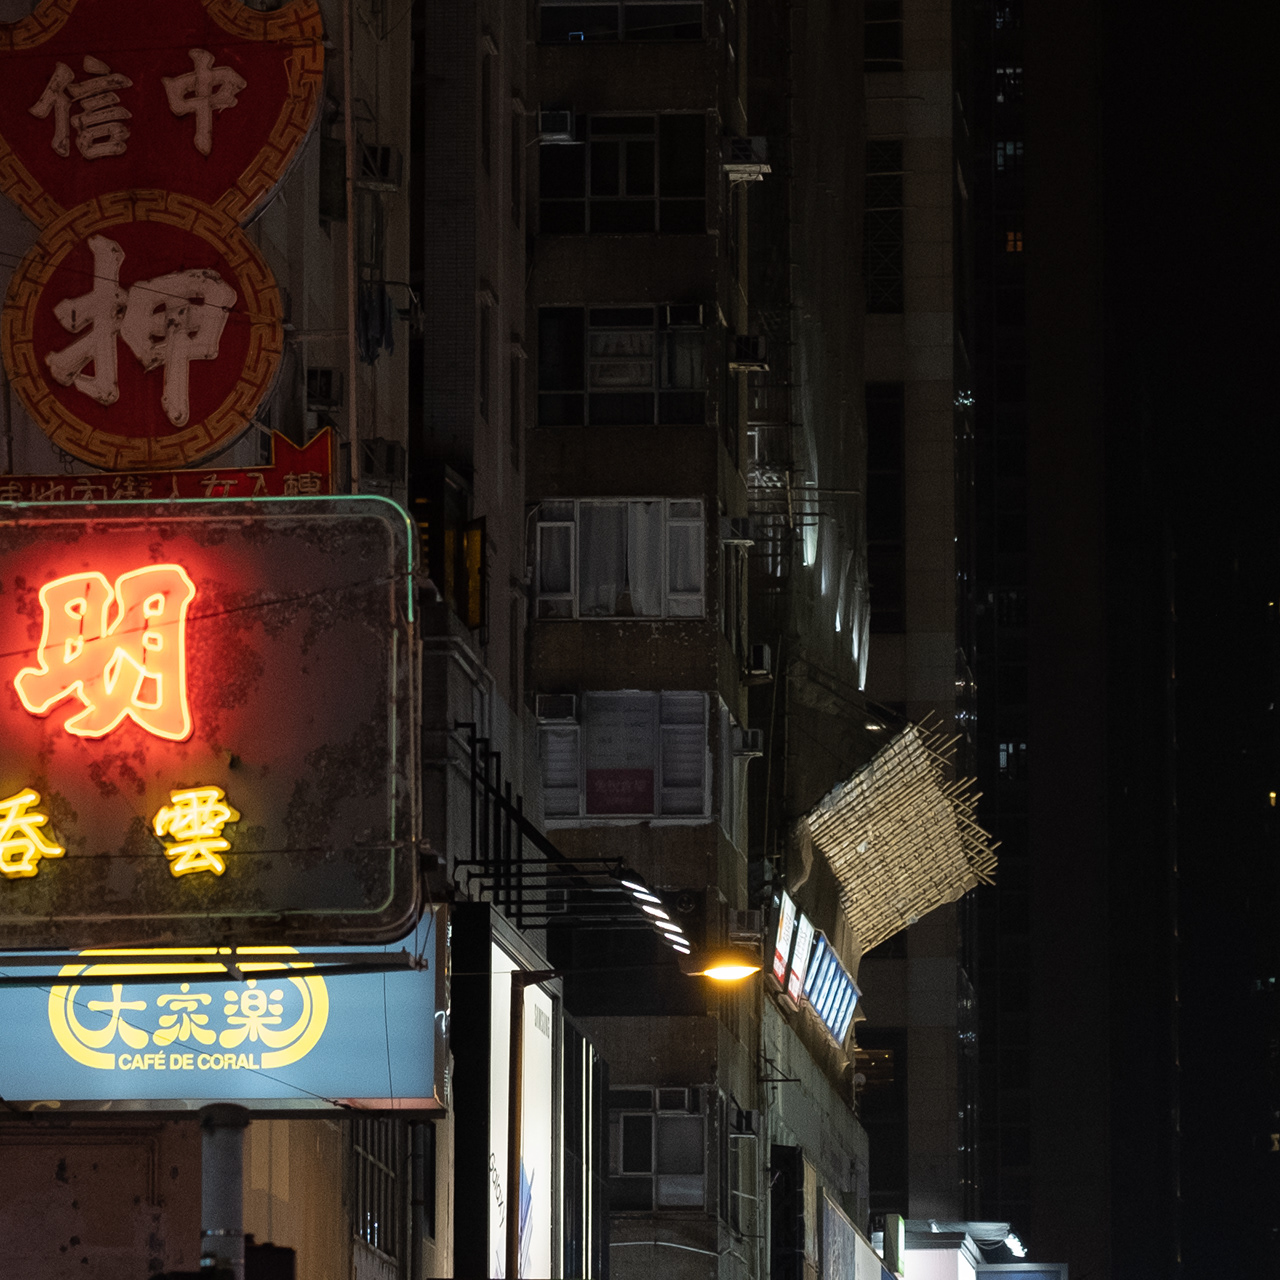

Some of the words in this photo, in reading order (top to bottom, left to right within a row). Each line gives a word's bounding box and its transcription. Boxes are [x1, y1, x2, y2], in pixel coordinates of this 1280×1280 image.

[28, 48, 247, 160] 中信
[44, 234, 238, 428] 押
[118, 1050, 166, 1070] CAFÉ
[169, 1054, 194, 1070] DE
[197, 1053, 260, 1070] CORAL
